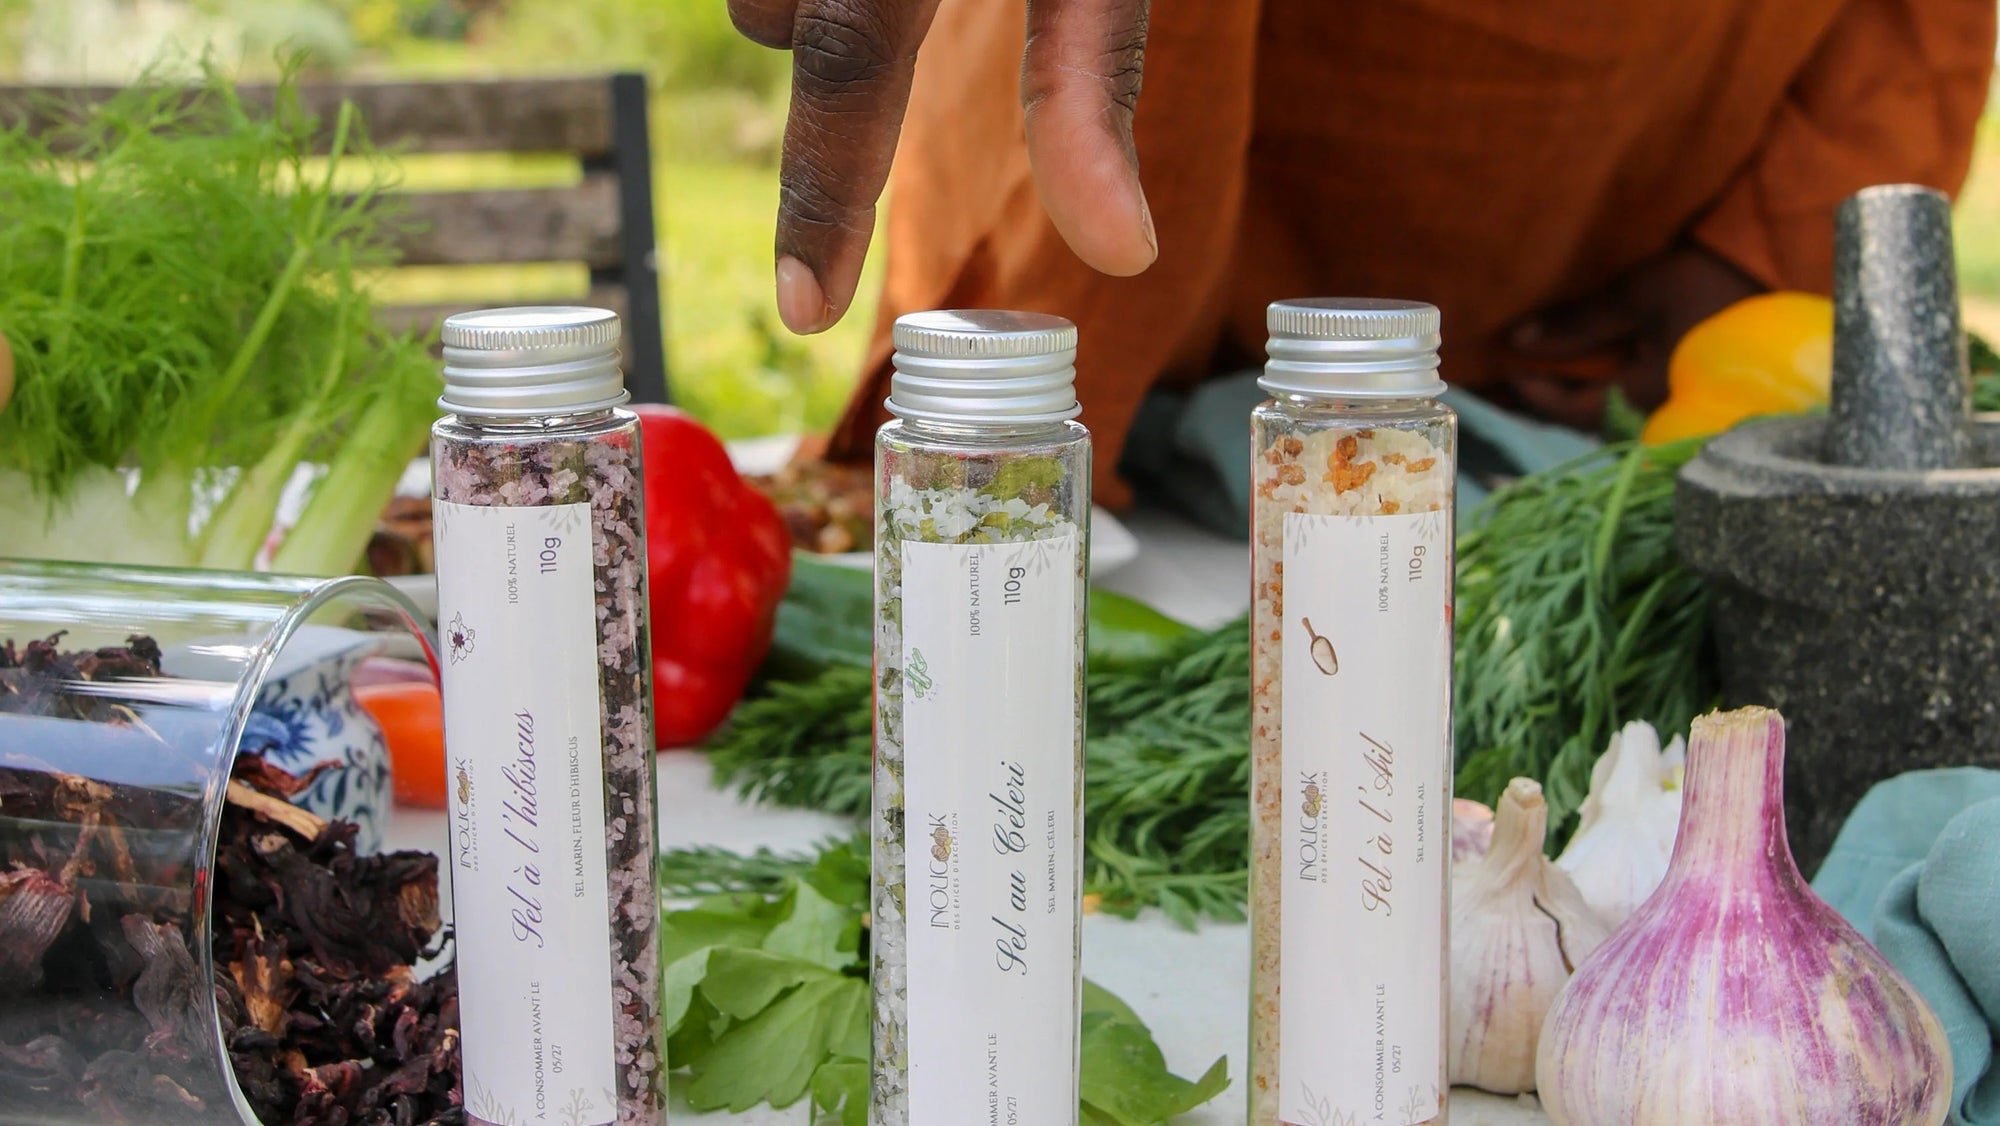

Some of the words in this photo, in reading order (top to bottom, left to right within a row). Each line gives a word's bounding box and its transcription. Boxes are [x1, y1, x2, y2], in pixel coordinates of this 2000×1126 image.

[506, 522, 516, 575] NATUREL
[539, 537, 561, 575] 110g
[1380, 532, 1388, 584] NATUREL
[1409, 546, 1426, 583] 110g
[507, 578, 518, 604] 100%
[970, 553, 979, 606] NATUREL
[1004, 567, 1025, 605] 110g
[1379, 586, 1388, 612] 100%
[970, 610, 980, 636] 100%
[568, 736, 580, 797] D'HIBISCUS
[571, 800, 582, 834] FLEUR
[989, 760, 1030, 855] Céleri
[572, 836, 583, 877] MARIN,
[1366, 832, 1392, 855] à
[513, 862, 541, 885] à
[1047, 851, 1056, 892] MARIN,
[1358, 857, 1392, 917] Sel
[1010, 870, 1026, 912] au
[507, 885, 544, 949] Sel
[991, 915, 1027, 976] Sel
[531, 981, 540, 993] LE
[1376, 983, 1385, 996] LE
[531, 997, 542, 1035] AVANT
[1376, 999, 1385, 1036] AVANT
[988, 1033, 997, 1045] LE
[533, 1038, 545, 1109] CONSOMMER
[552, 1044, 562, 1073] 05/27
[988, 1048, 997, 1087] AVANT
[1375, 1039, 1384, 1111] CONSOMMER
[1392, 1045, 1401, 1073] 05/27
[989, 1090, 998, 1126] MMER
[1007, 1096, 1017, 1125] 05/27
